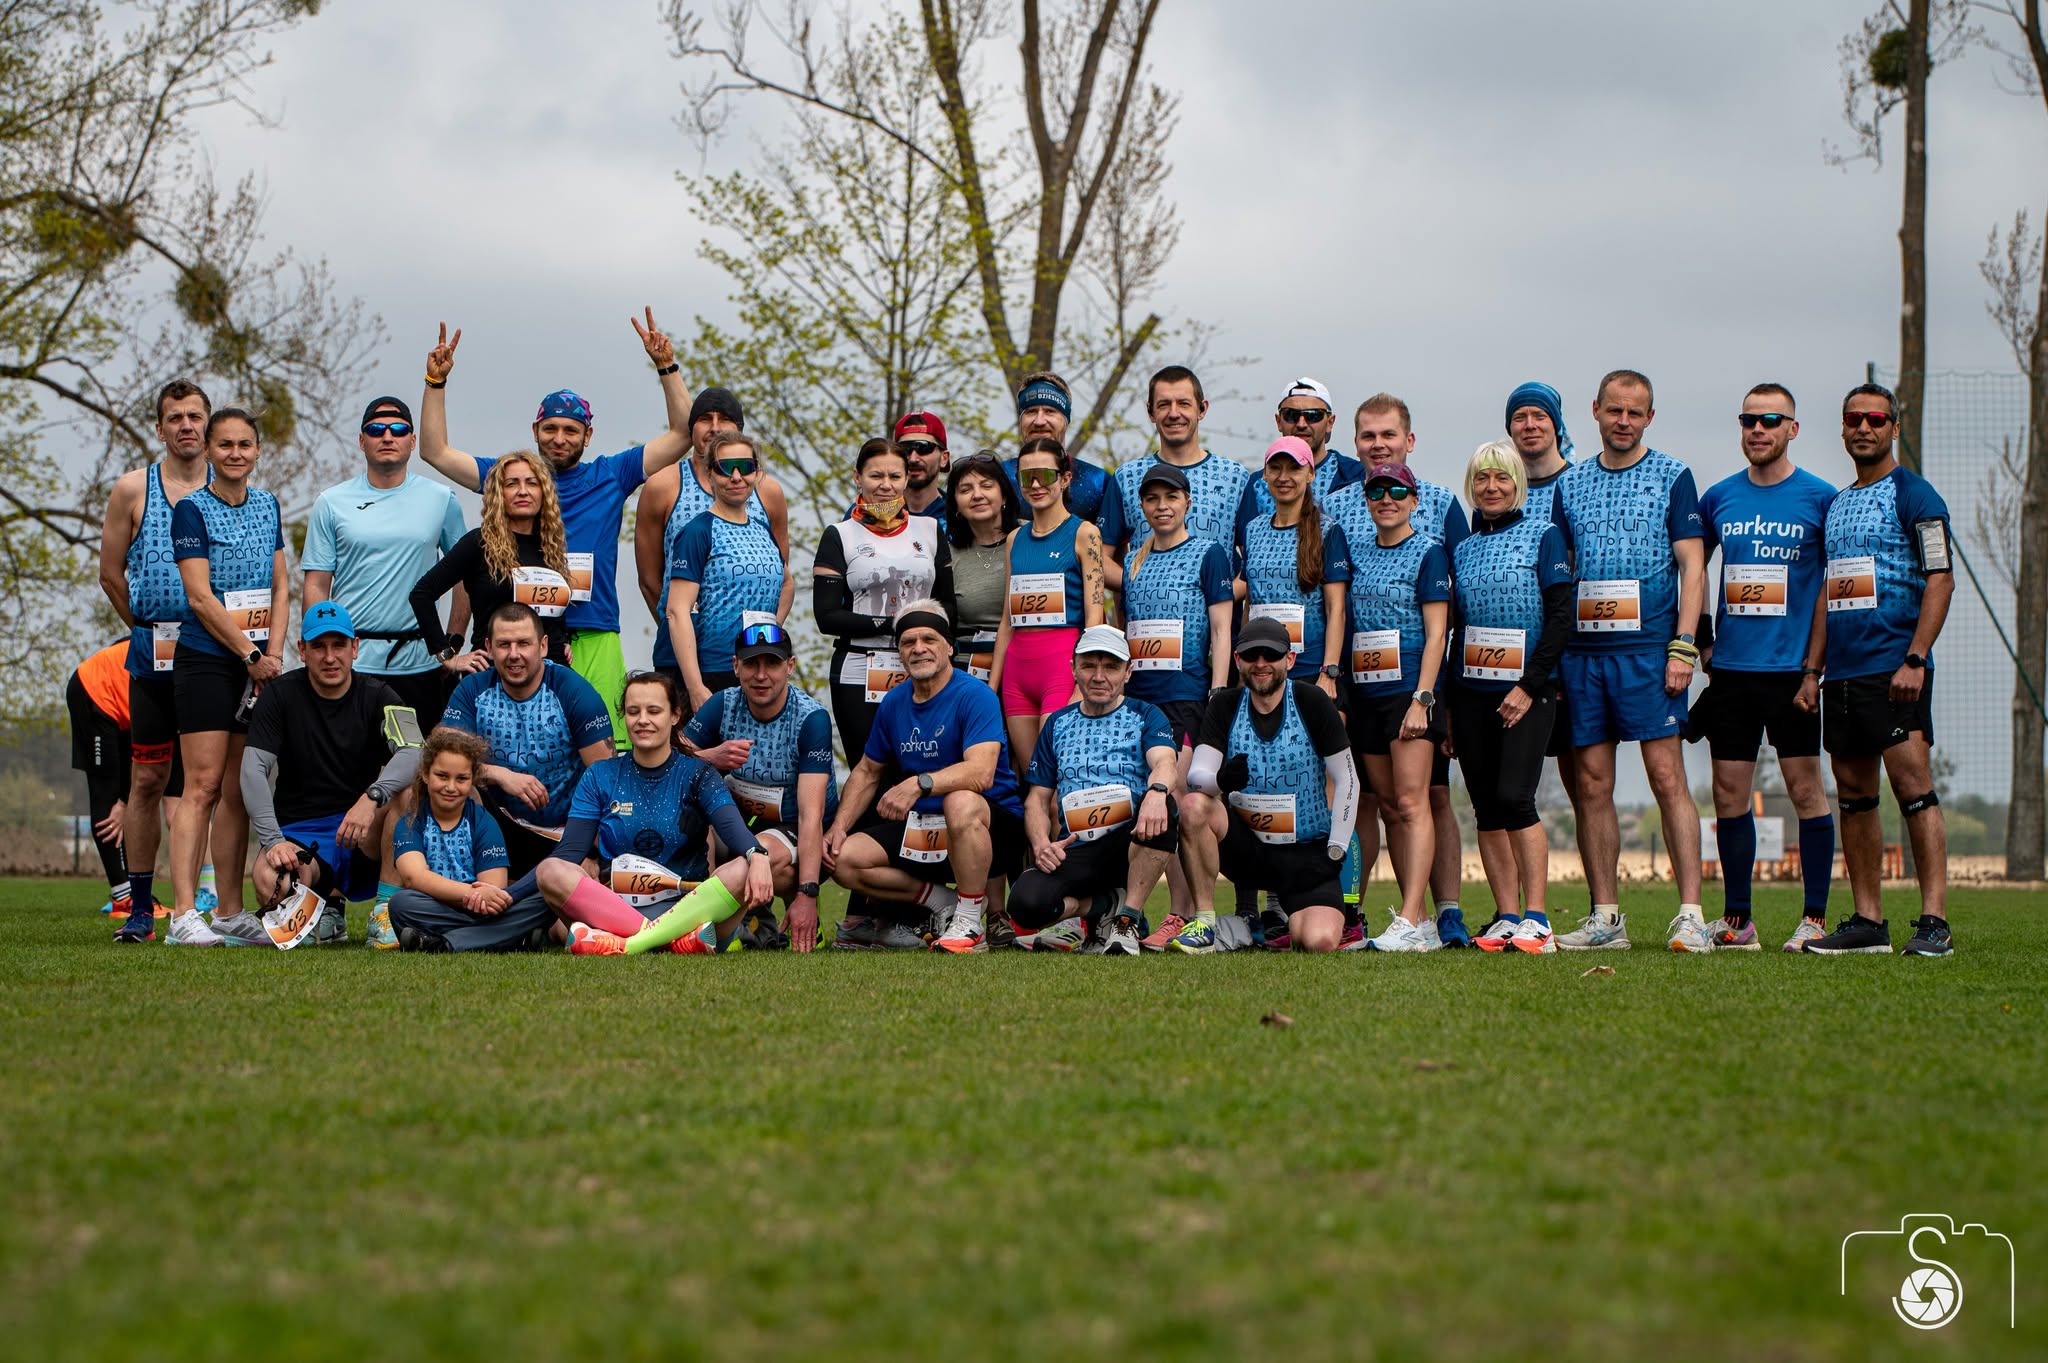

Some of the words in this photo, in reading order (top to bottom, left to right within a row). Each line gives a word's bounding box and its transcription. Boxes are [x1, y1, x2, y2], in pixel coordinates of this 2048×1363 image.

[1721, 514, 1804, 542] parkrun
[1751, 539, 1801, 561] Toruń
[531, 586, 559, 604] 138
[1740, 584, 1766, 602] 23
[1837, 578, 1855, 597] 50
[1020, 594, 1048, 612] 132
[1592, 600, 1618, 619] 53
[247, 609, 269, 628] 157
[1139, 639, 1162, 657] 110
[1476, 647, 1506, 666] 179
[1362, 651, 1382, 670] 33
[901, 735, 939, 756] parkrun
[1087, 805, 1111, 827] 67
[1250, 812, 1274, 830] 92
[927, 830, 939, 849] 91
[288, 909, 307, 934] 93
